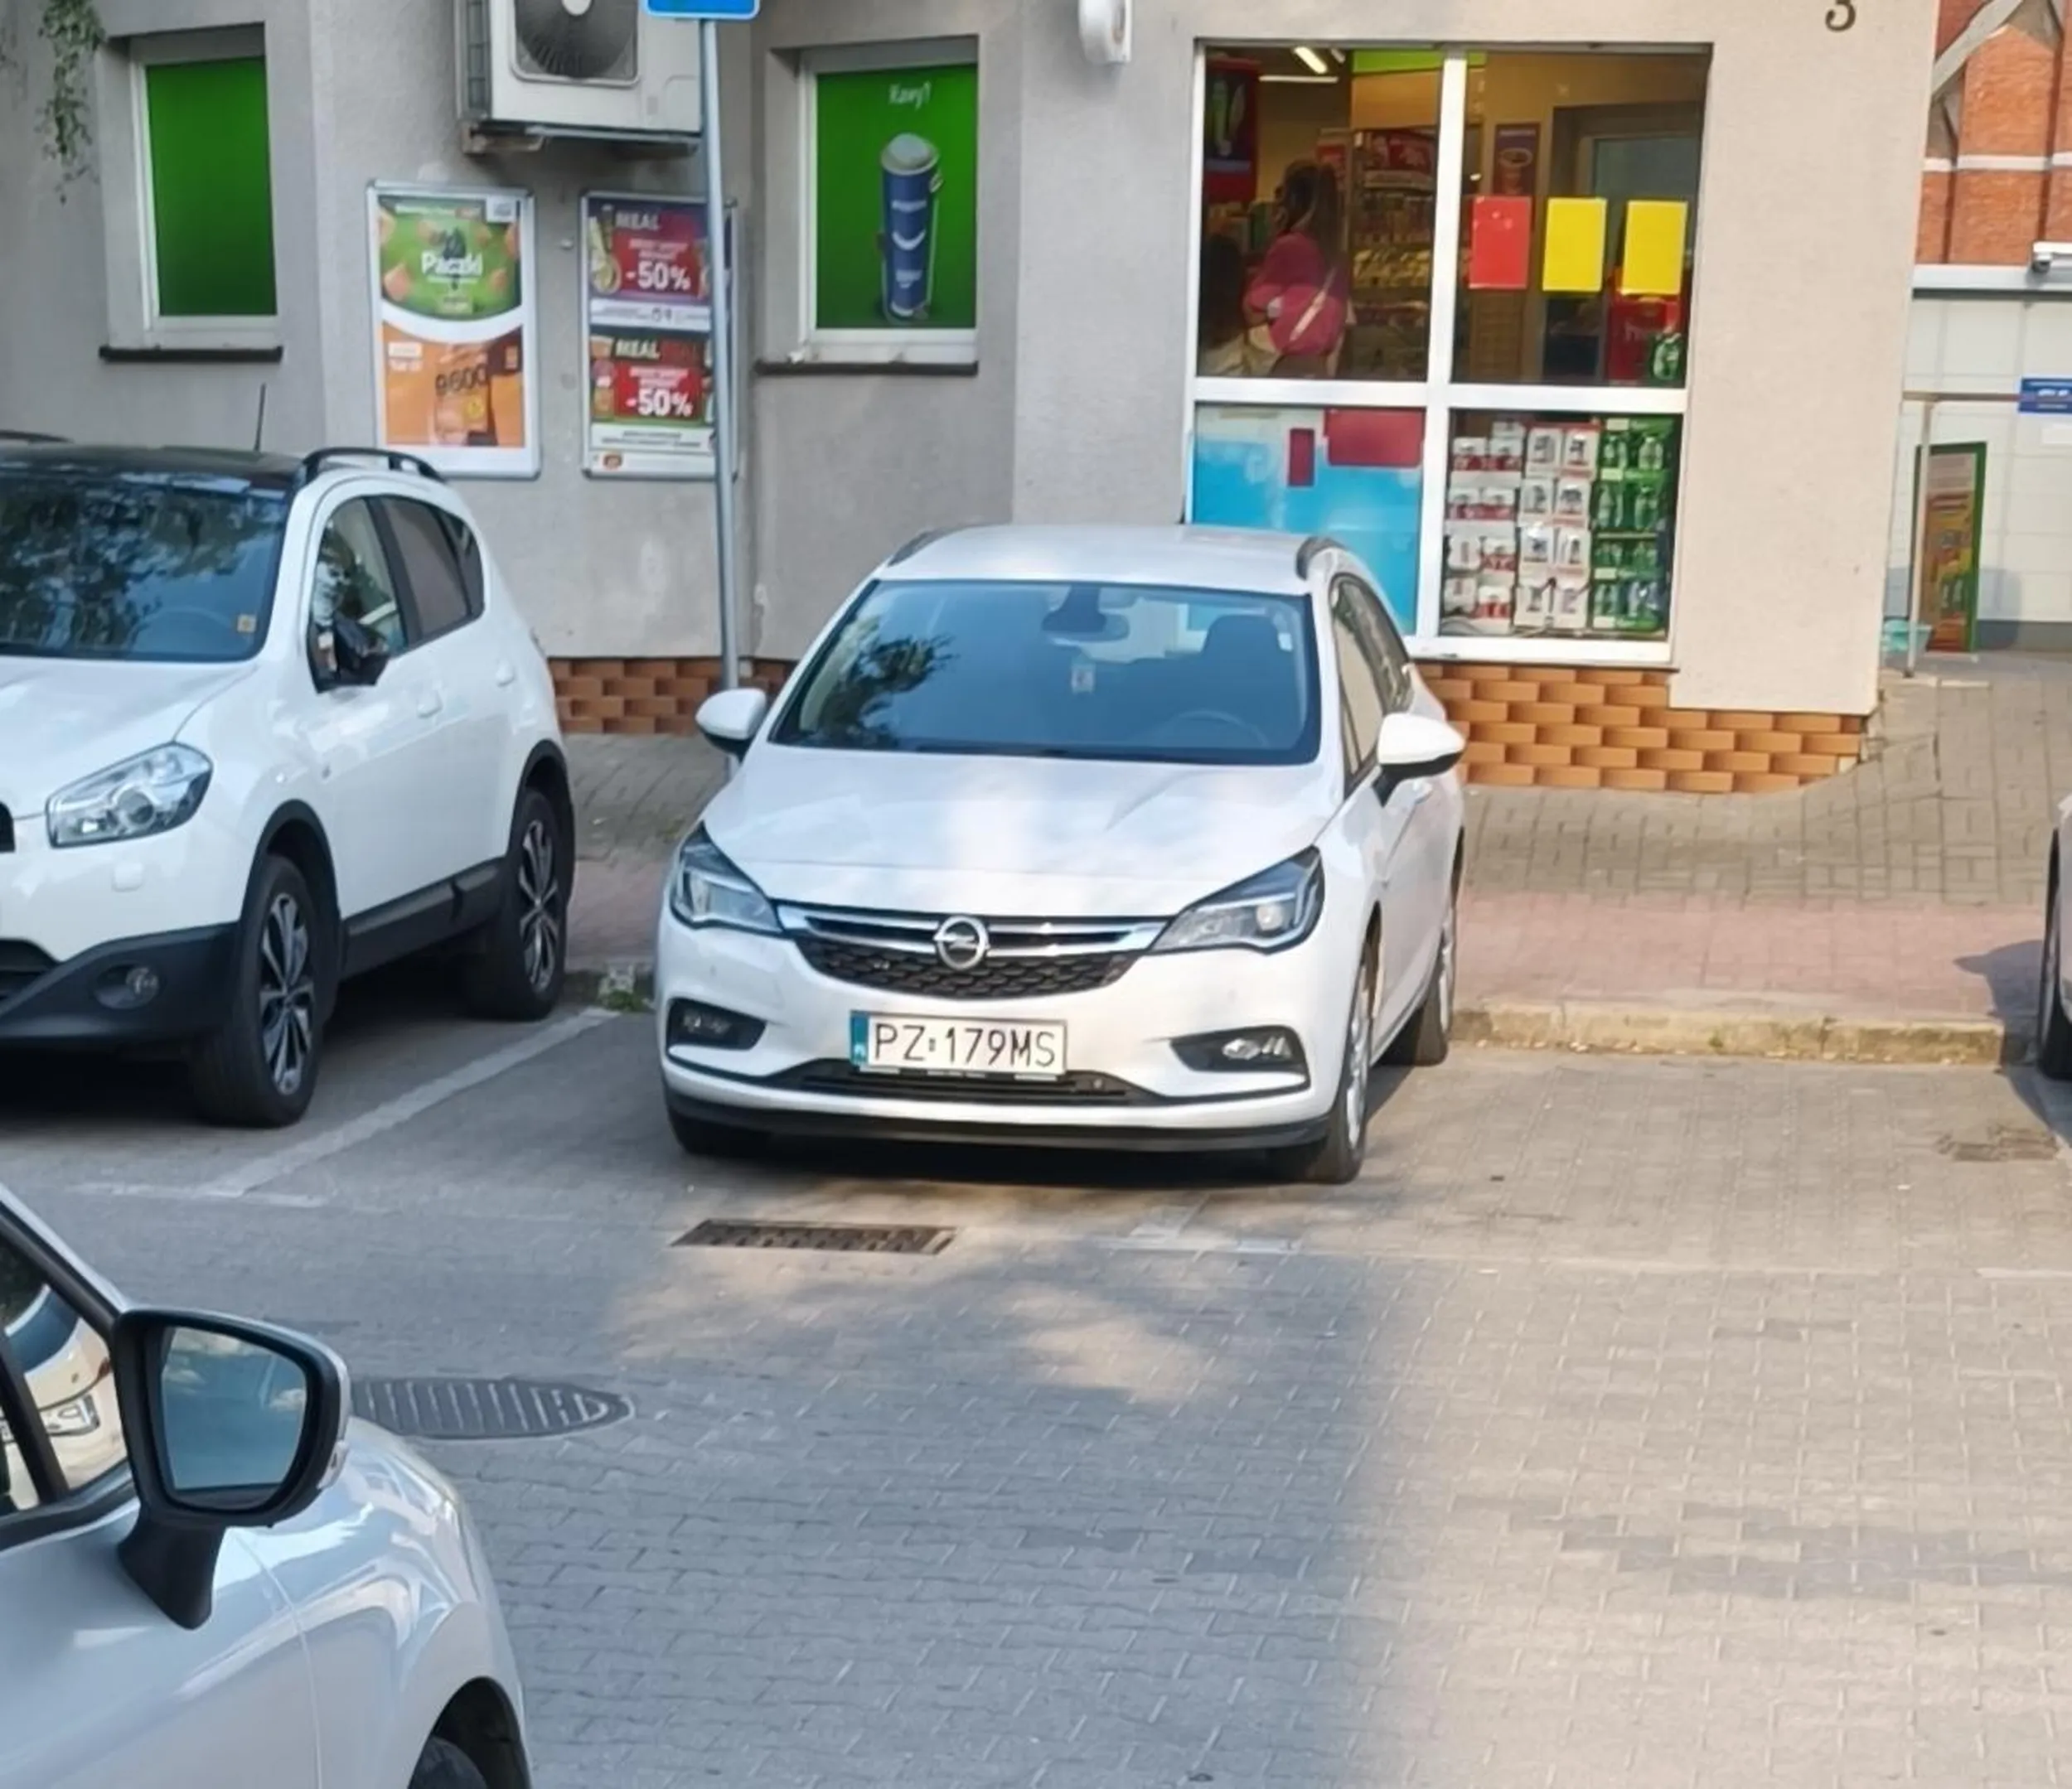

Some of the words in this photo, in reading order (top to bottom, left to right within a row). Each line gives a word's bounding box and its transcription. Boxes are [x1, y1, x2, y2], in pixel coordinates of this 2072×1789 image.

[626, 260, 691, 291] -50%
[626, 388, 693, 417] -50%
[875, 1023, 926, 1061] PZ
[946, 1027, 1055, 1067] 179MS
